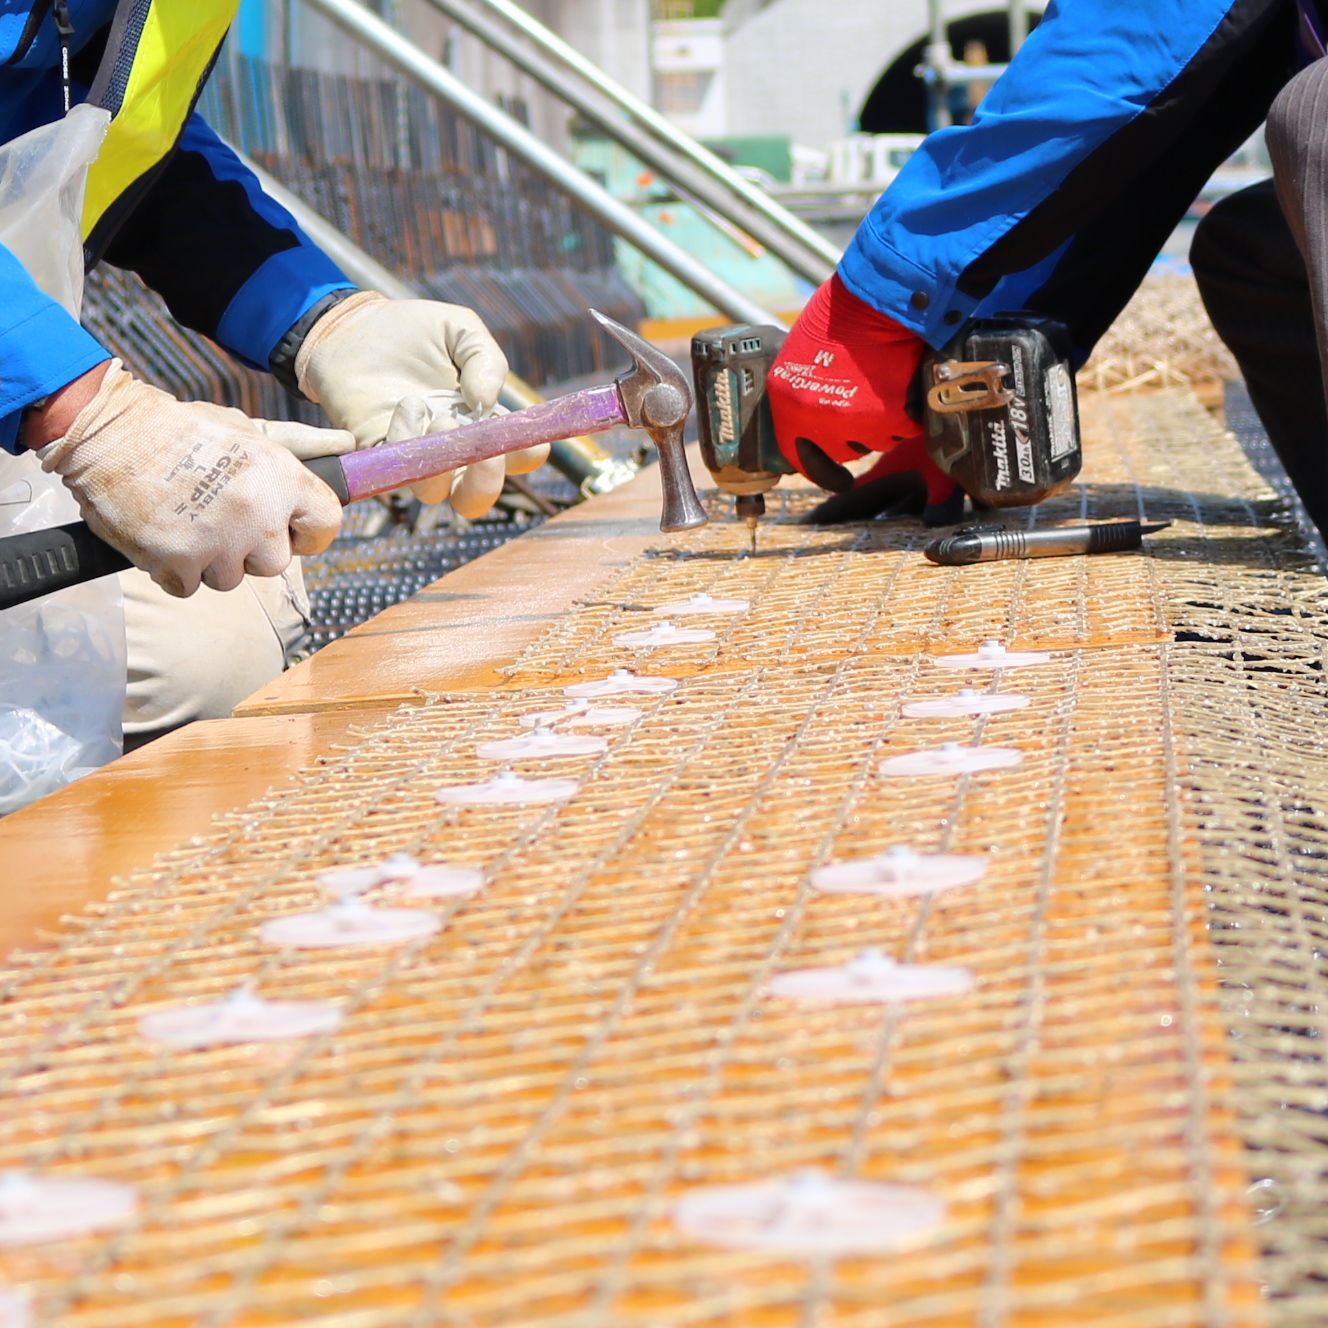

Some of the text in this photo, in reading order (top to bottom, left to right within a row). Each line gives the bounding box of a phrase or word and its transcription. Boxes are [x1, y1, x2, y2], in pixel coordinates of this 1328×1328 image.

[814, 349, 834, 367] M
[714, 367, 735, 444] makita
[773, 366, 859, 399] PowerGrab
[1010, 396, 1029, 431] 18V
[190, 455, 232, 502] GRIP
[991, 418, 1011, 492] makita
[189, 451, 248, 522] ASSEMBLY
